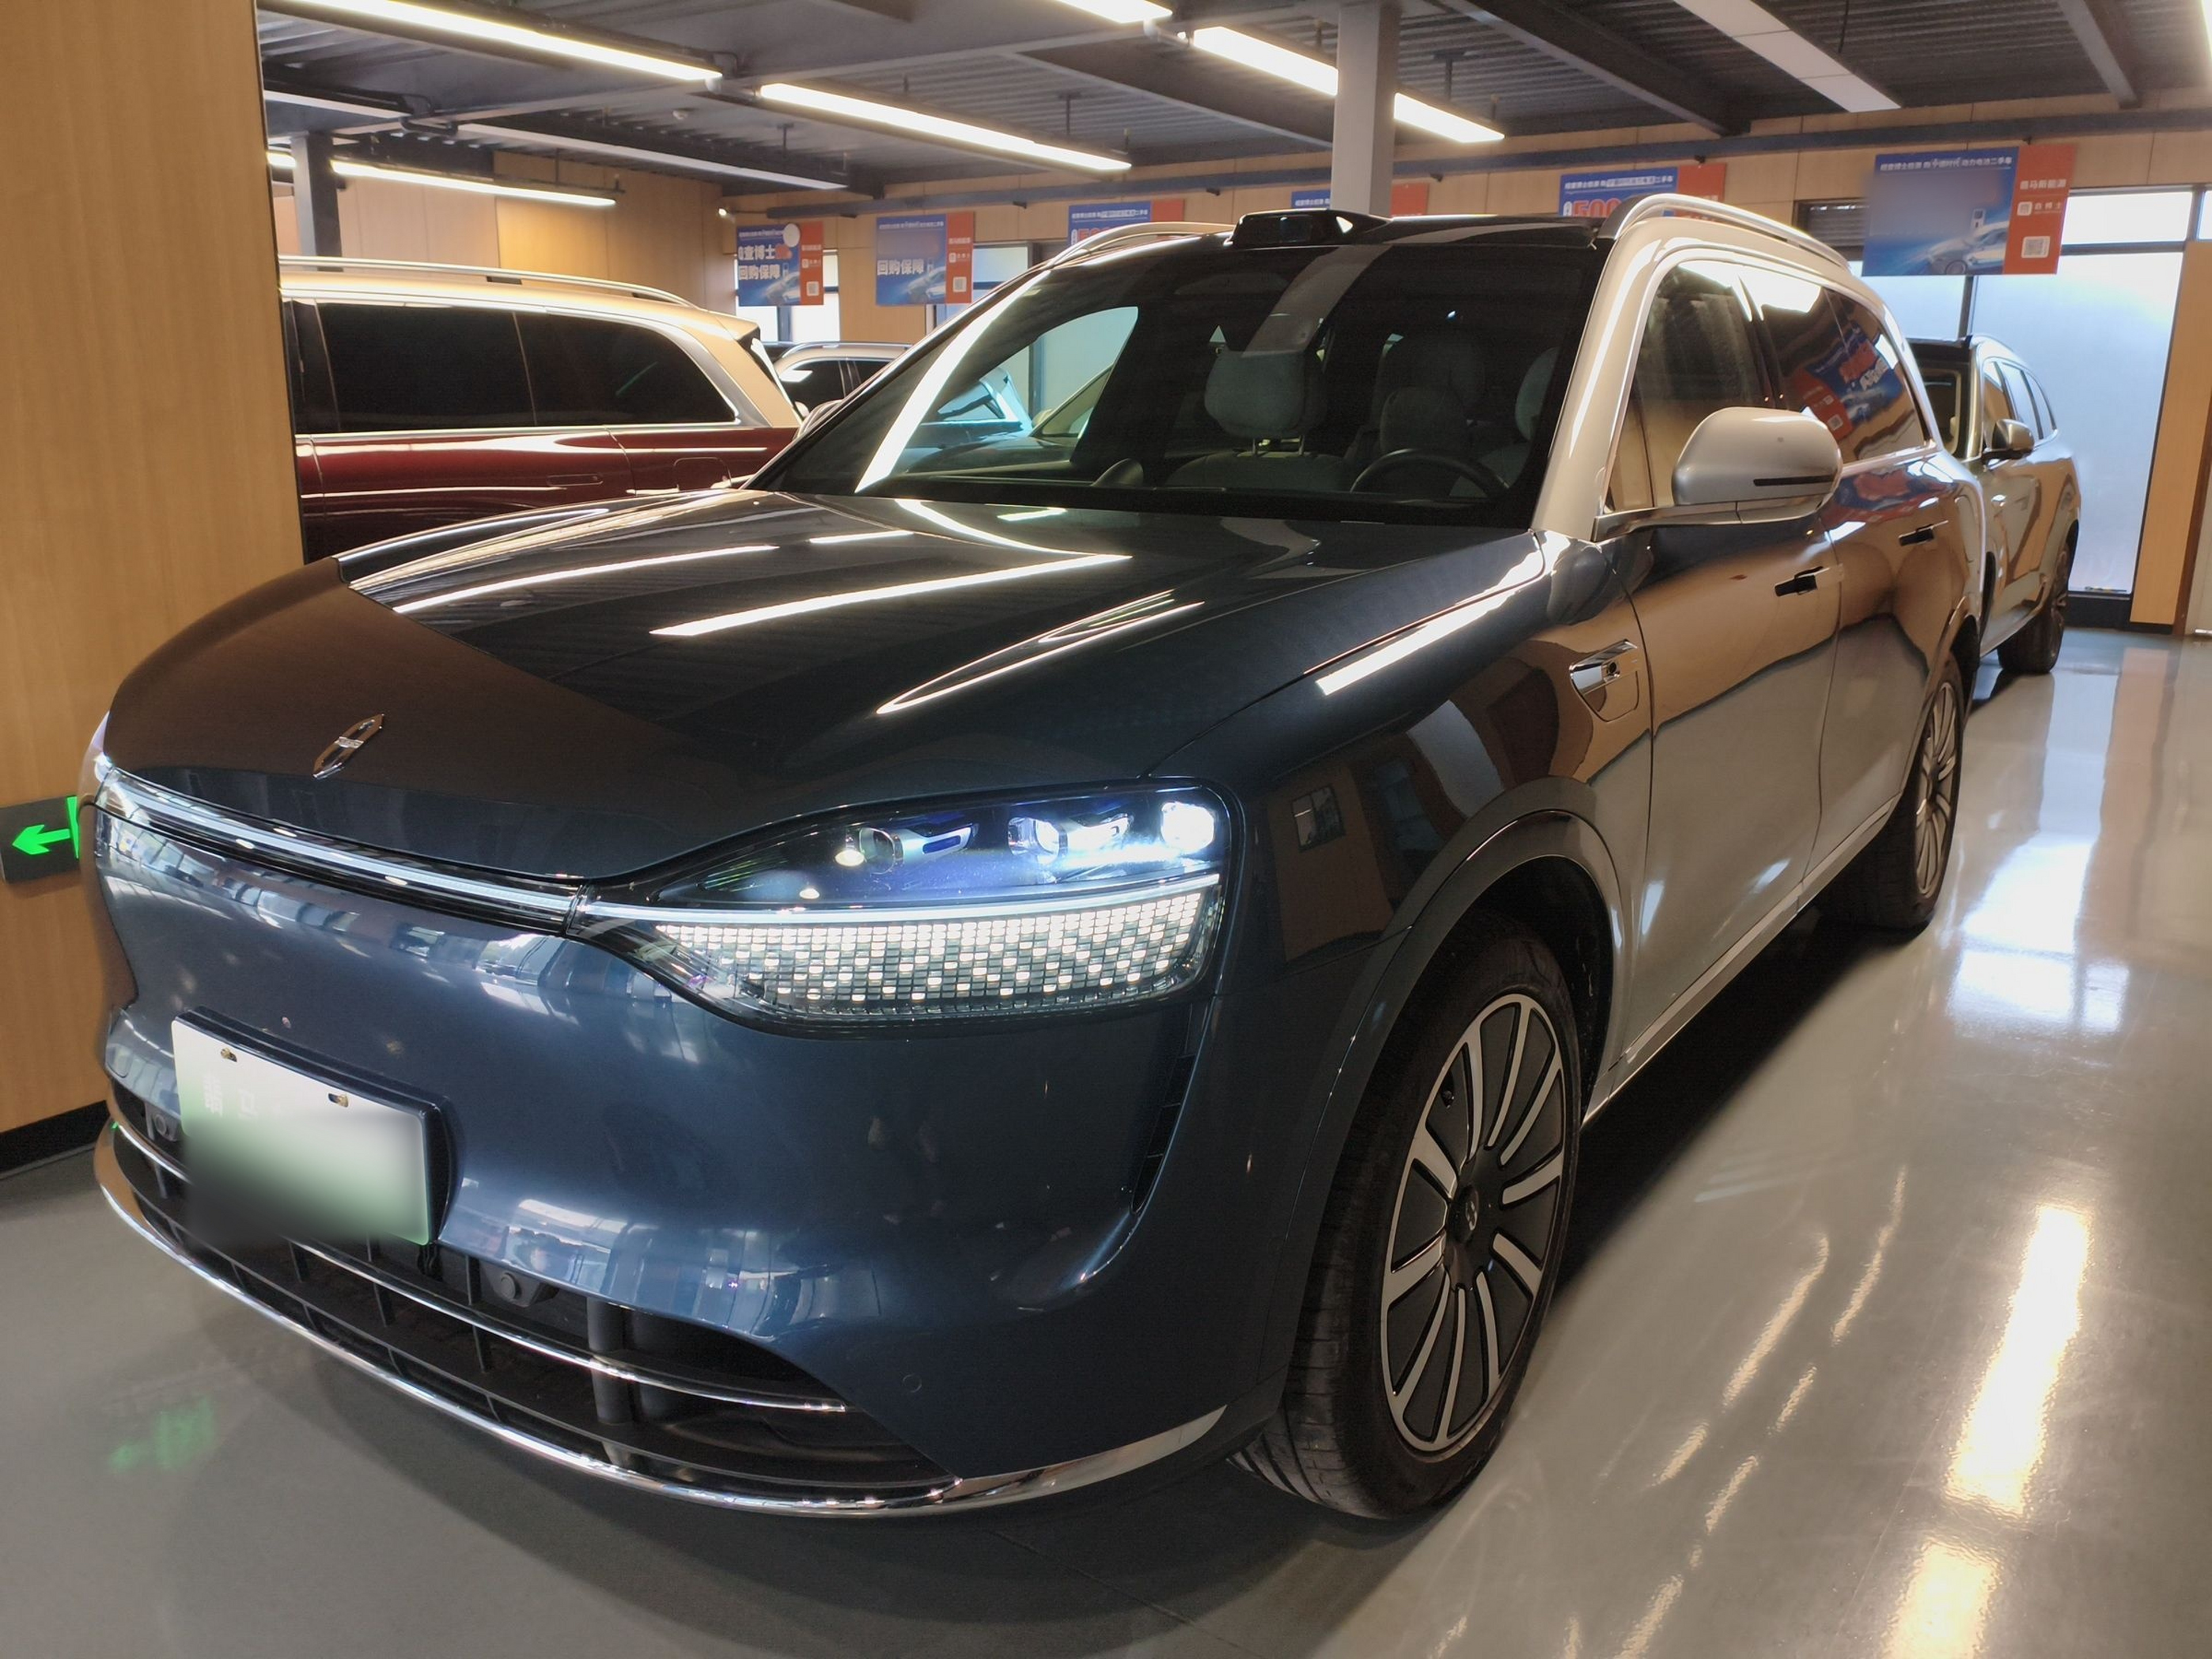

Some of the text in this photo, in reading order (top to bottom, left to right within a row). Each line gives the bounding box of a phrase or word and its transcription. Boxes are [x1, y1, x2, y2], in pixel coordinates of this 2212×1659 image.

[738, 264, 781, 281] 回购保障
[877, 259, 925, 276] 回购保障
